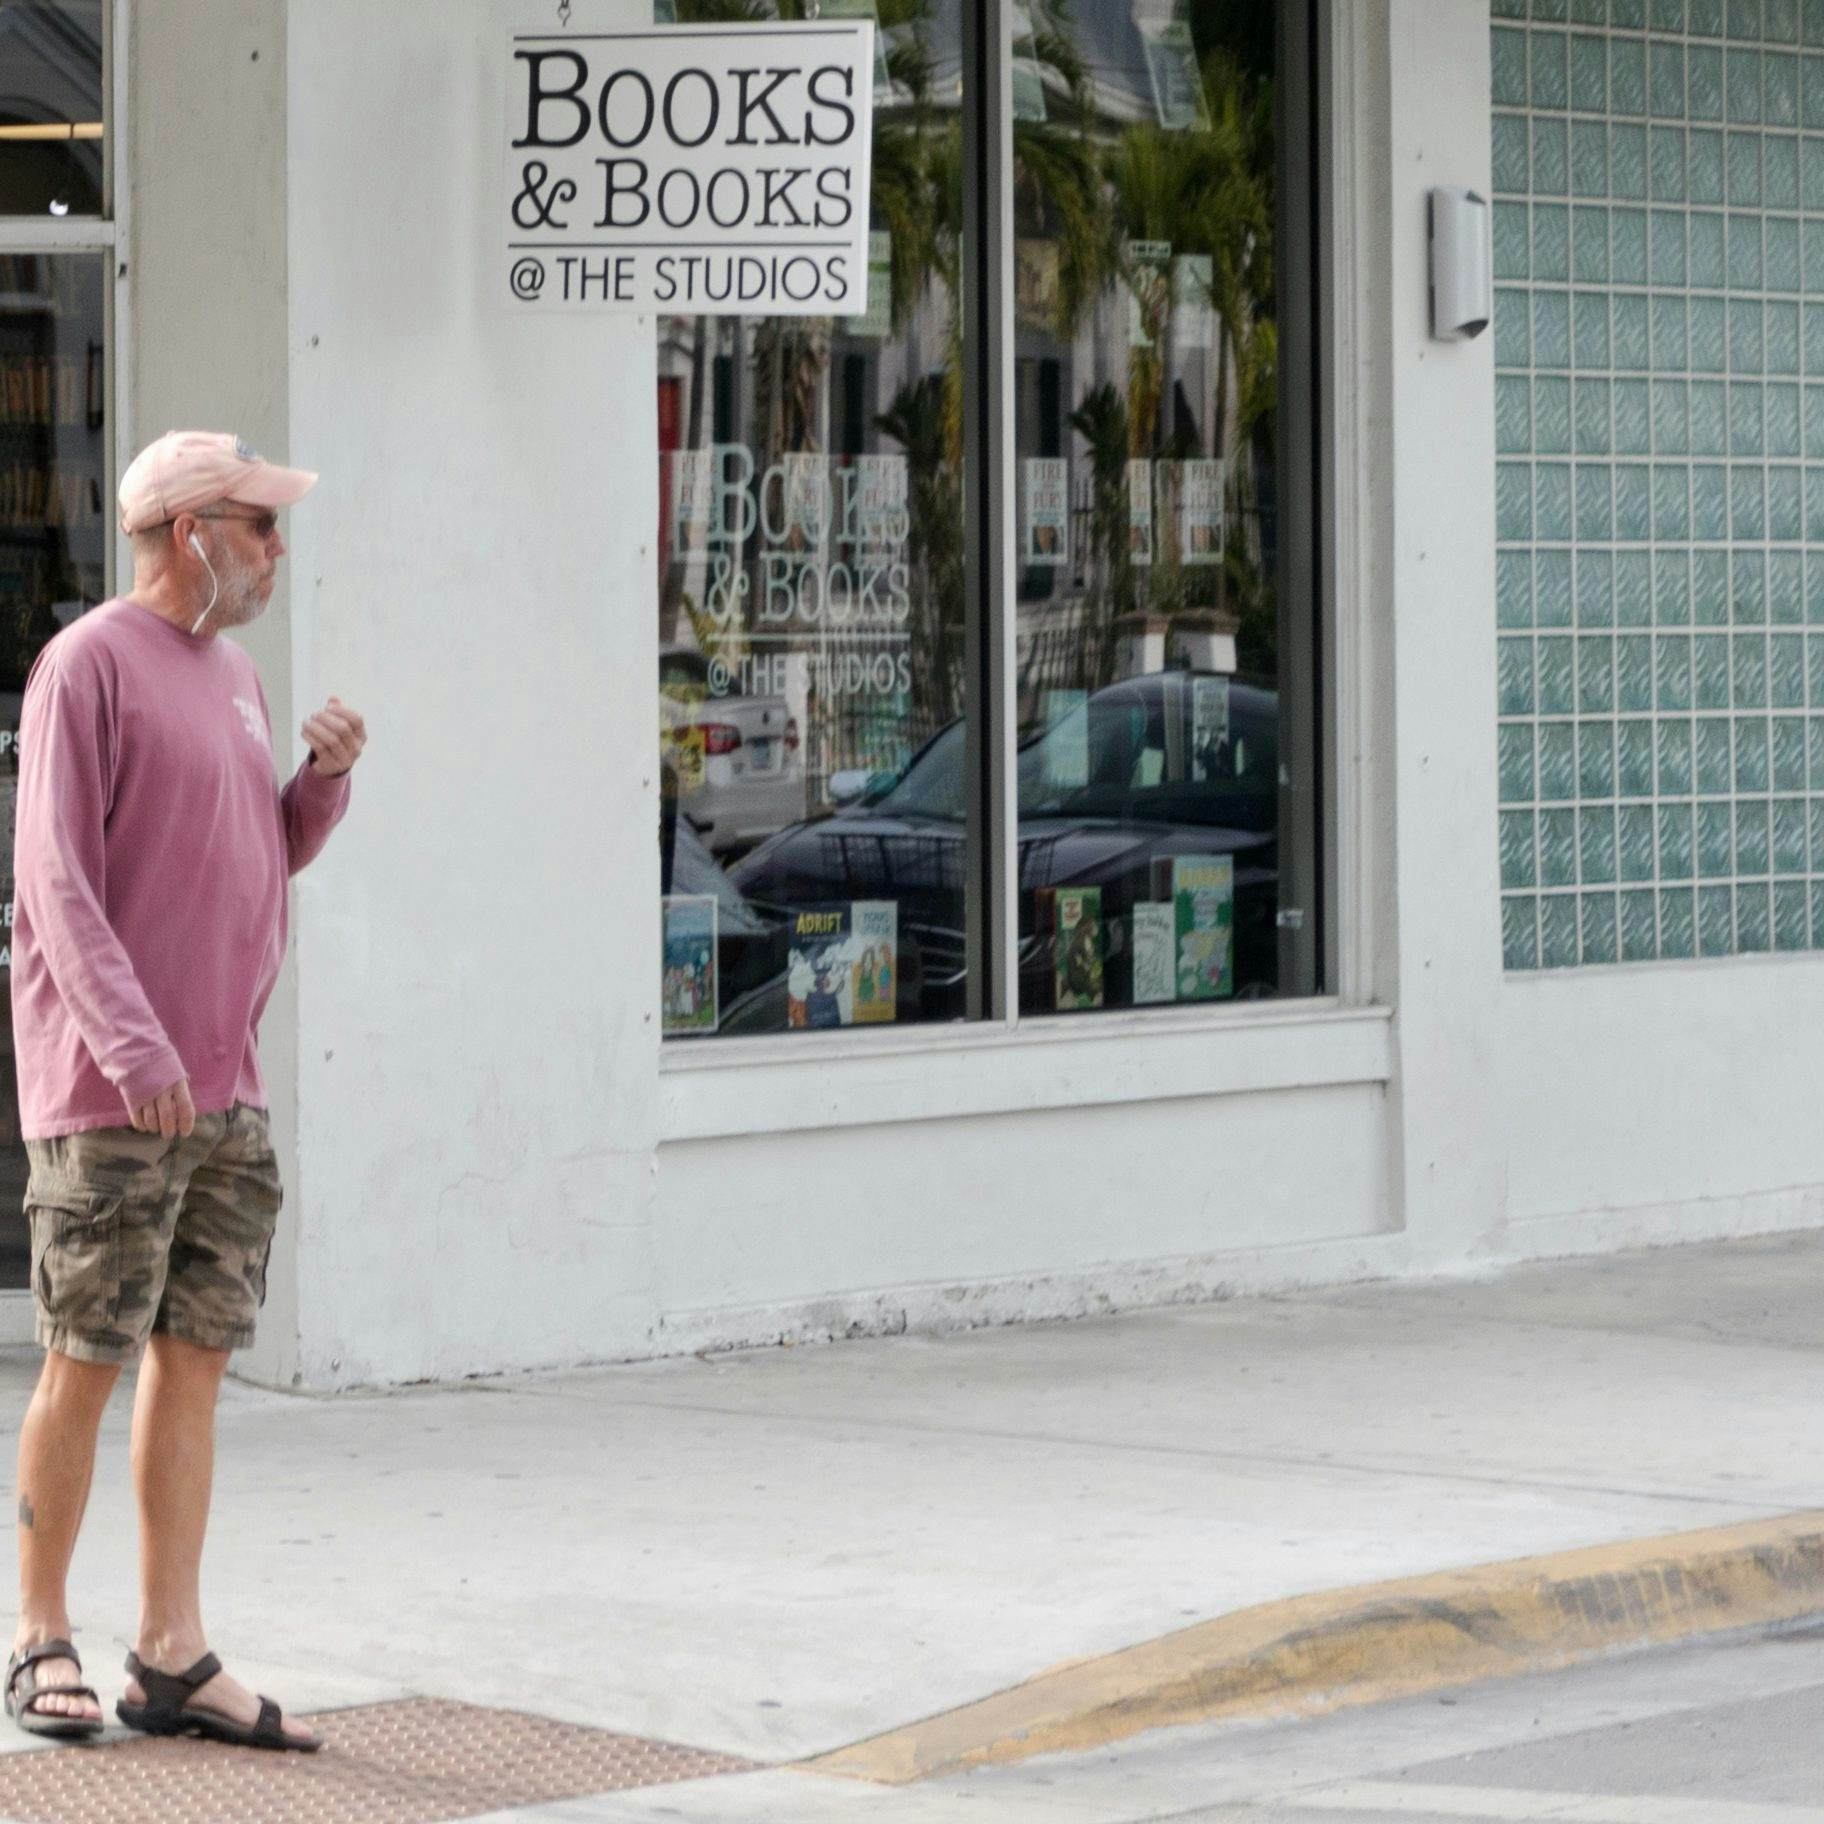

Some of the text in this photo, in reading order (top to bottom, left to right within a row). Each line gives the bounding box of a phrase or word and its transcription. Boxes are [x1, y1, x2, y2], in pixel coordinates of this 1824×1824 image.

[510, 49, 856, 149] BOOKS
[511, 158, 853, 230] & BOOKS
[509, 257, 850, 303] @ THE STUDIOS
[707, 442, 911, 545] BOOKS
[707, 549, 911, 625] & BOOKS
[707, 653, 911, 697] @ THE STUDIOS
[796, 912, 843, 935] ADRIFT
